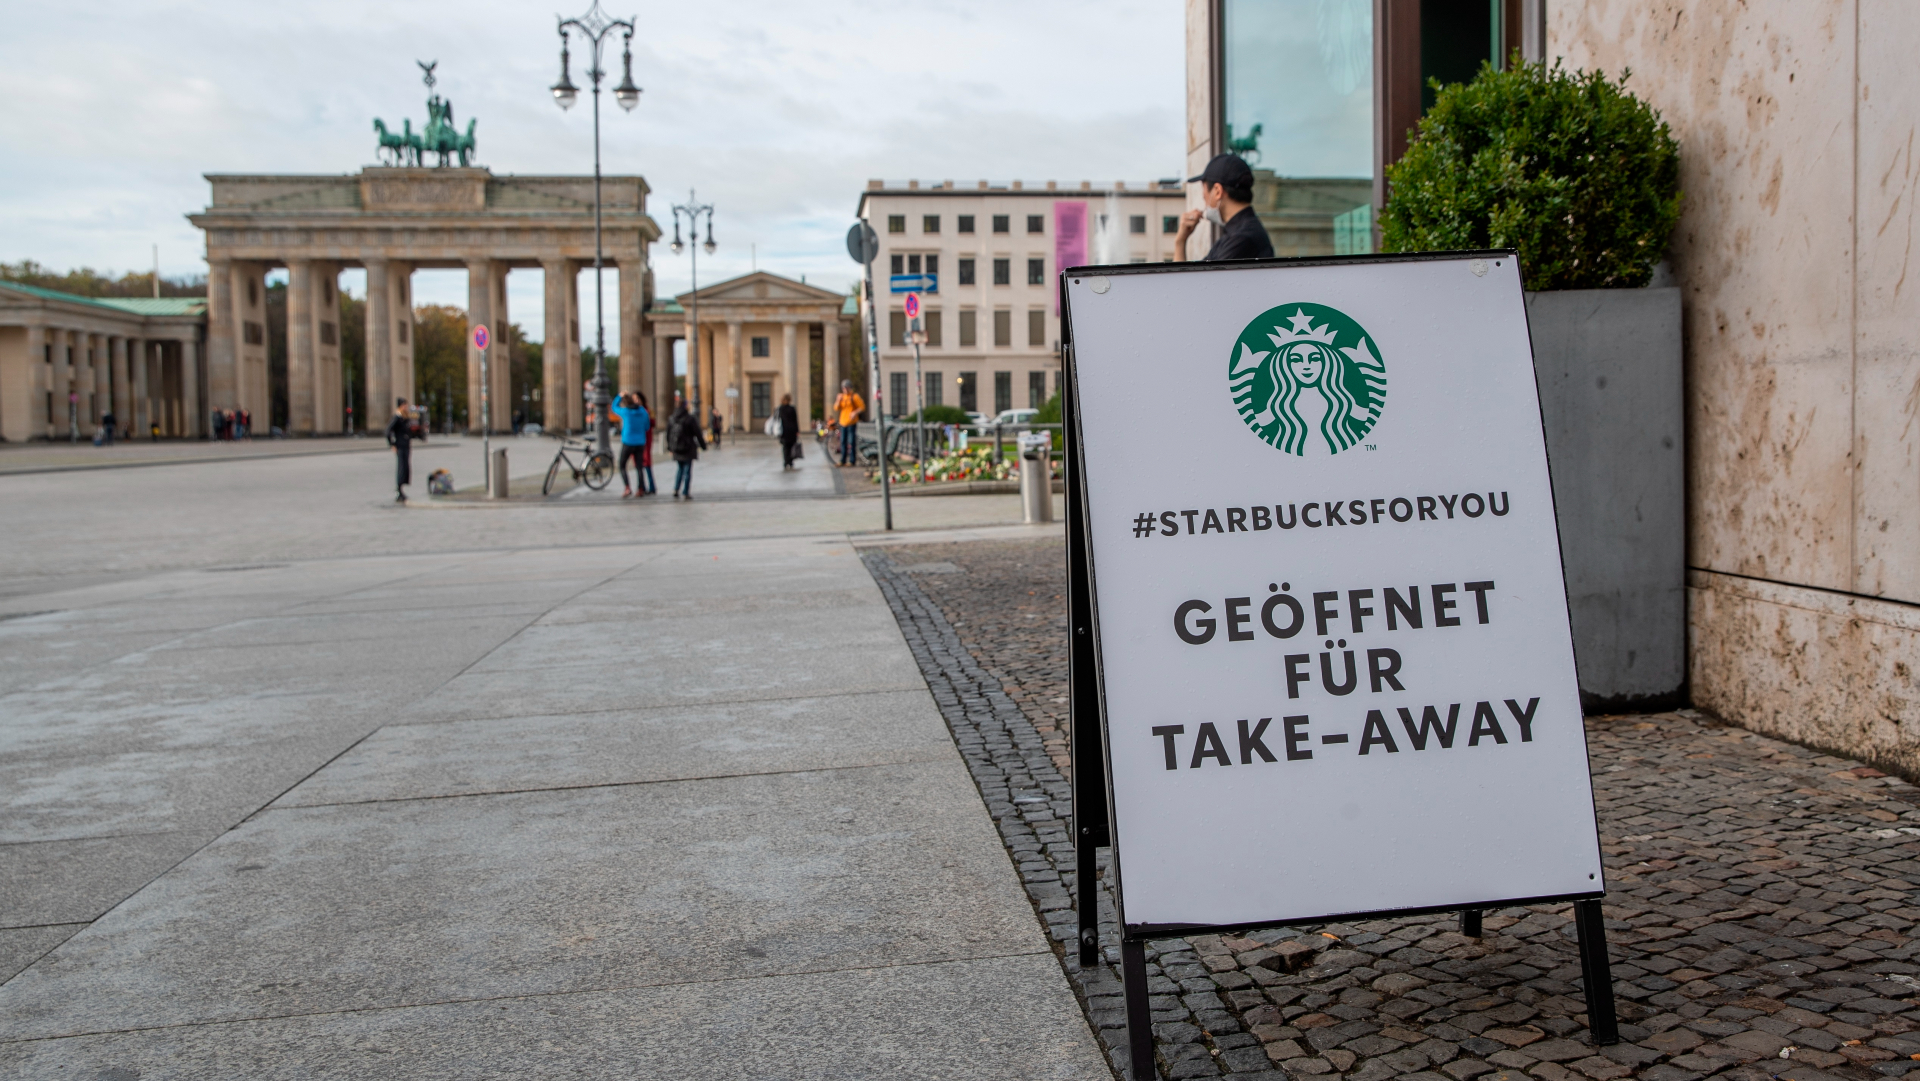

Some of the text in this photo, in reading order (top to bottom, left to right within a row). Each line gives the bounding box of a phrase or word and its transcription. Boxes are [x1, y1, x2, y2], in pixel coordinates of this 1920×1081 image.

[1364, 444, 1377, 452] TM
[1132, 492, 1510, 538] #STARBUCKSFORYOU
[1174, 581, 1496, 645] GEÖFFNET
[1284, 639, 1406, 699] FÜR
[1152, 698, 1541, 770] TAKE-AWAY
